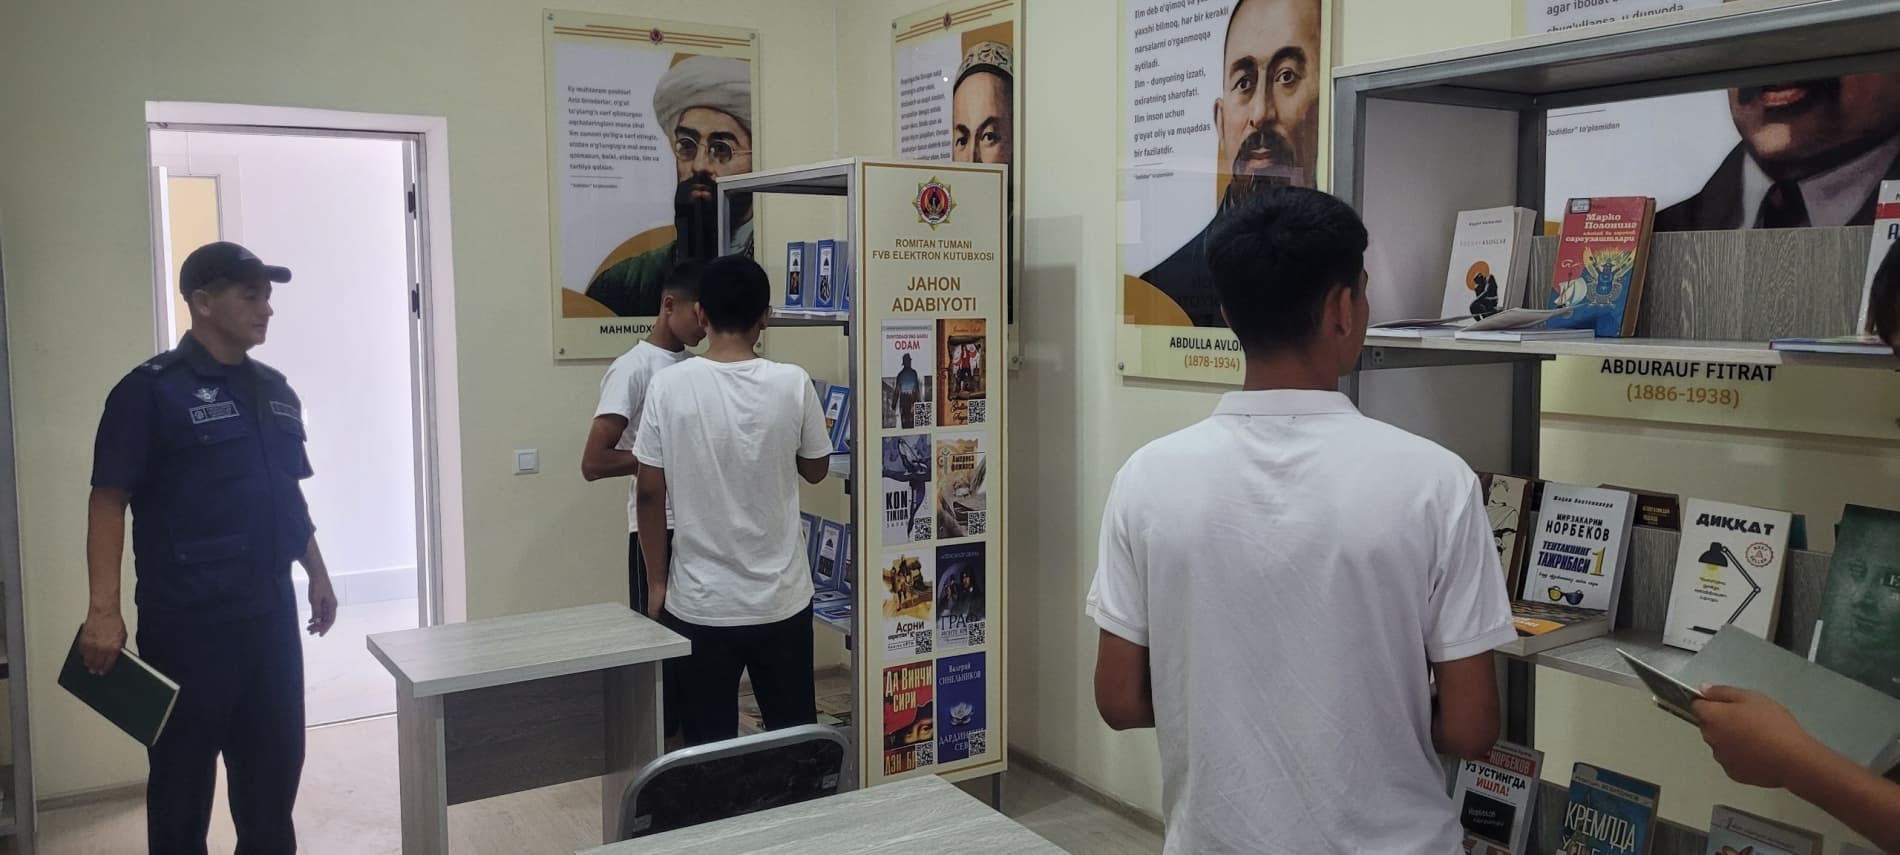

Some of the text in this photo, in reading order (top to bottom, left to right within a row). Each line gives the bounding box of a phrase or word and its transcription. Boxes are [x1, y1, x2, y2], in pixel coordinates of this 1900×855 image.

[1146, 6, 1158, 16] deb
[1547, 2, 1571, 16] agar
[1134, 24, 1154, 38] yaxshi
[1181, 16, 1193, 26] har
[1194, 12, 1204, 23] bir
[1205, 6, 1229, 19] kerakli
[1146, 111, 1164, 121] inson
[1165, 108, 1185, 118] uchun
[1176, 122, 1211, 135] muqaddas
[1134, 149, 1143, 158] bir
[1584, 221, 1638, 229] Полонинг
[1585, 213, 1621, 222] Марко
[895, 239, 972, 249] ROMITAN TUMANI
[872, 250, 995, 261] FVB ELEKTRON KUTUBXOSI
[907, 276, 961, 291] JAHON
[892, 297, 977, 312] ADABIYOTI
[600, 324, 656, 335] MAHMUDX
[895, 340, 920, 350] ODAM
[1169, 336, 1242, 352] ABDULLA AVLO
[1184, 354, 1240, 372] (1878-1934)
[1601, 358, 1776, 382] ABDURAUF FITRAT
[1626, 383, 1741, 409] (1886-1938)
[1556, 513, 1603, 526] МИРЗАКАРИМ
[1696, 513, 1775, 536] ДИҚҚАТ
[1545, 520, 1610, 541] НОРБЕКОВ
[1542, 540, 1592, 556] ТЕНТАКНИНГ
[1537, 546, 1606, 577] ТАЖРИБАСИ 1
[901, 665, 932, 690] ВИНЧИ
[893, 691, 917, 713] СИРИ
[1479, 765, 1526, 790] УСТИНГДА
[1475, 776, 1510, 797] ИШЛА!
[1564, 800, 1636, 854] КРЕМЛДА
